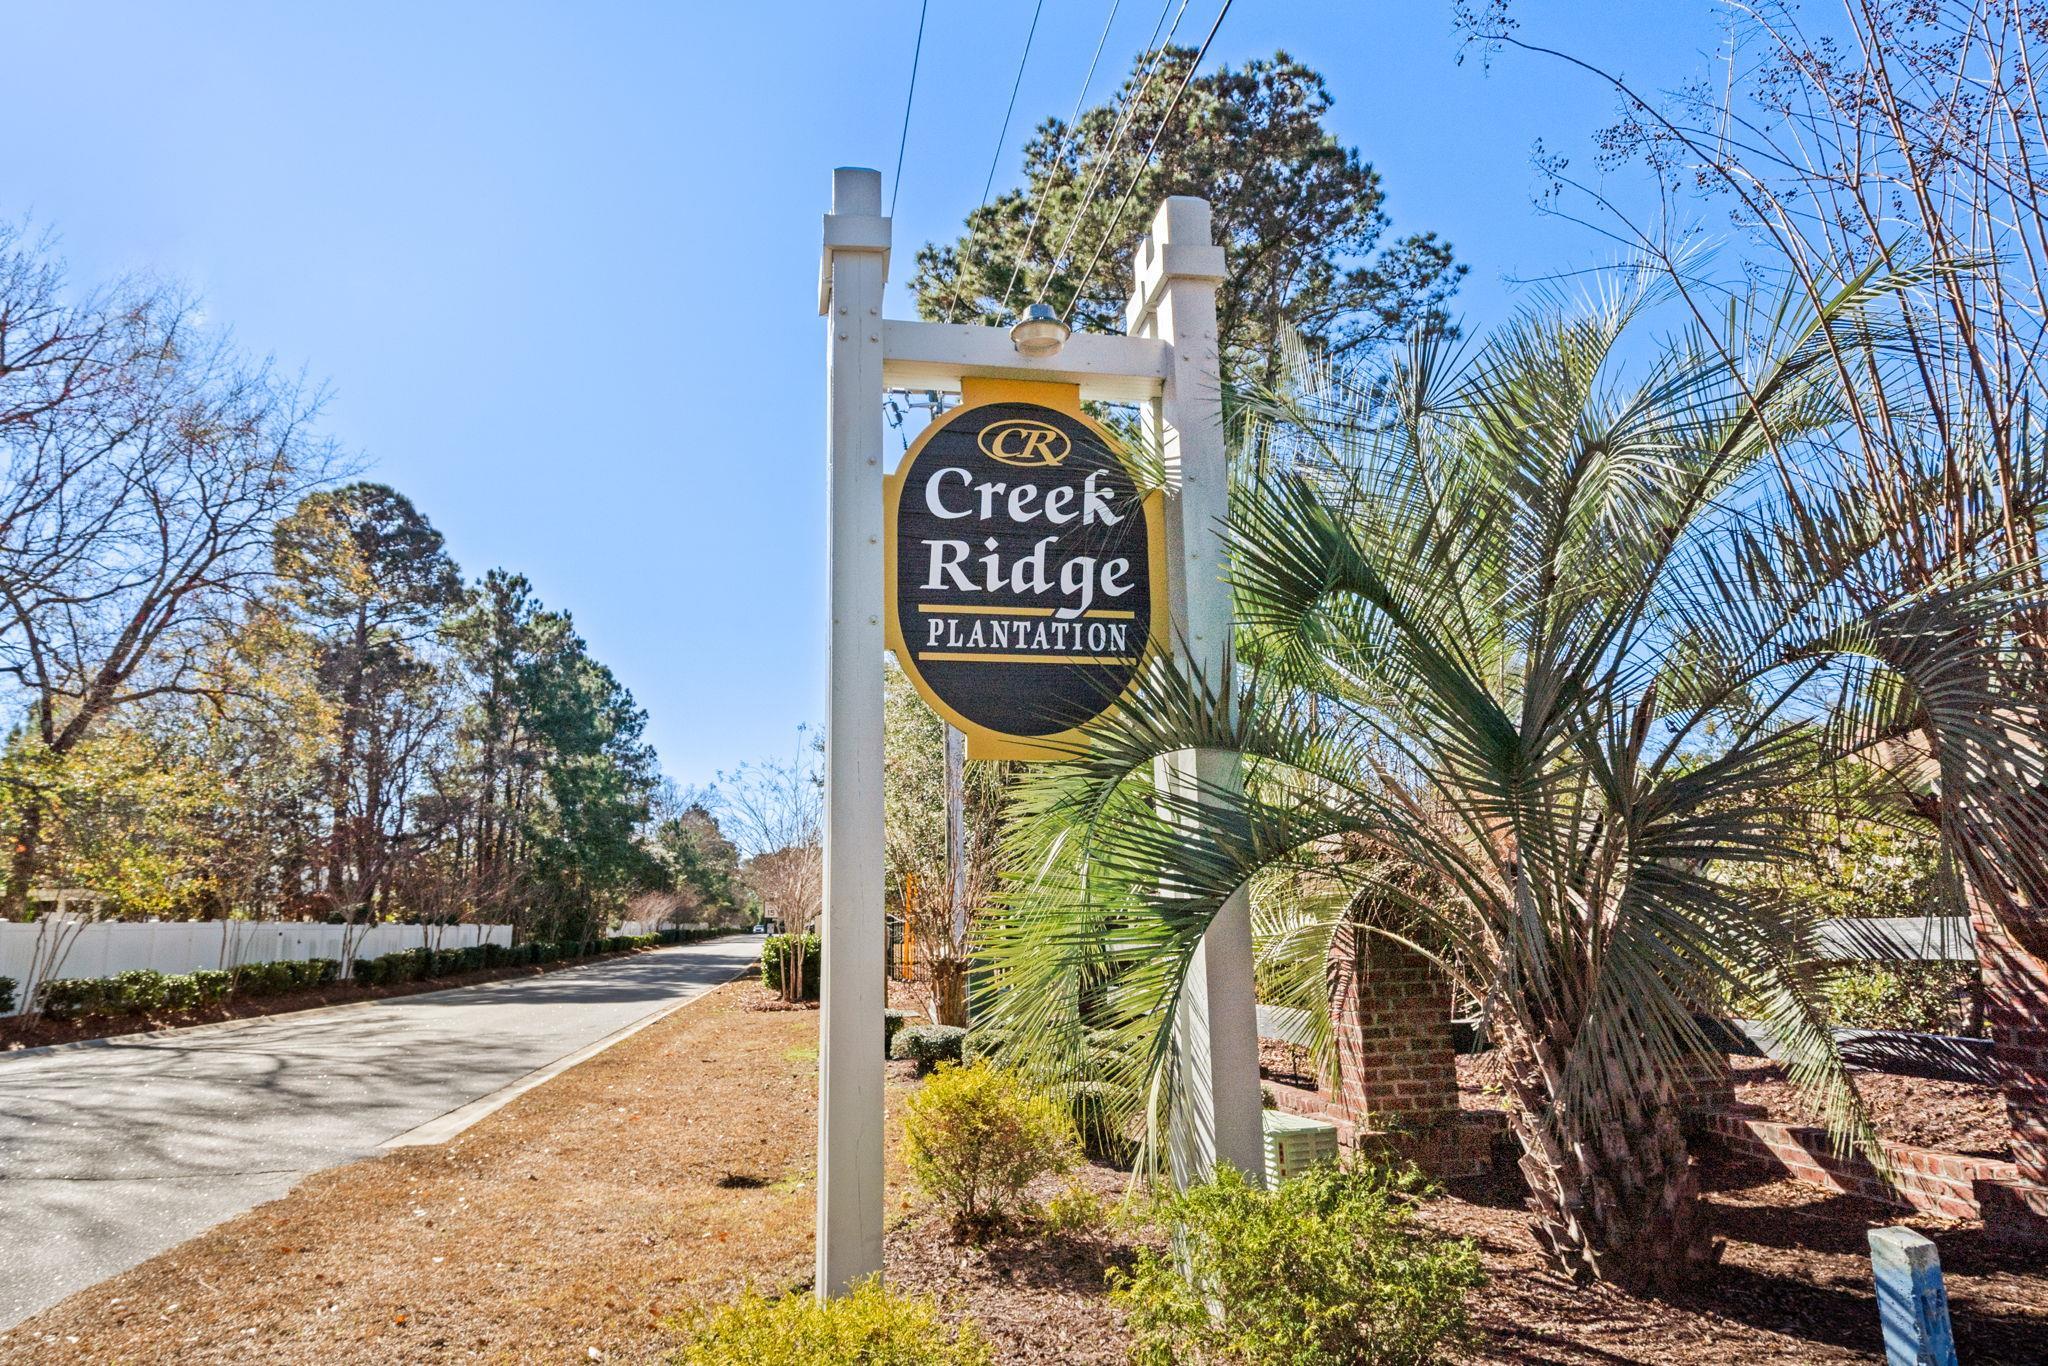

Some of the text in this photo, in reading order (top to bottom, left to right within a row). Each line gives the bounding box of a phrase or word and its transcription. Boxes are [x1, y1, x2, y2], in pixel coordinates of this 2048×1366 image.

[992, 428, 1063, 466] CR
[925, 467, 1125, 527] Creek
[919, 536, 1135, 619] Ridge
[926, 618, 1127, 651] PLANTATION
